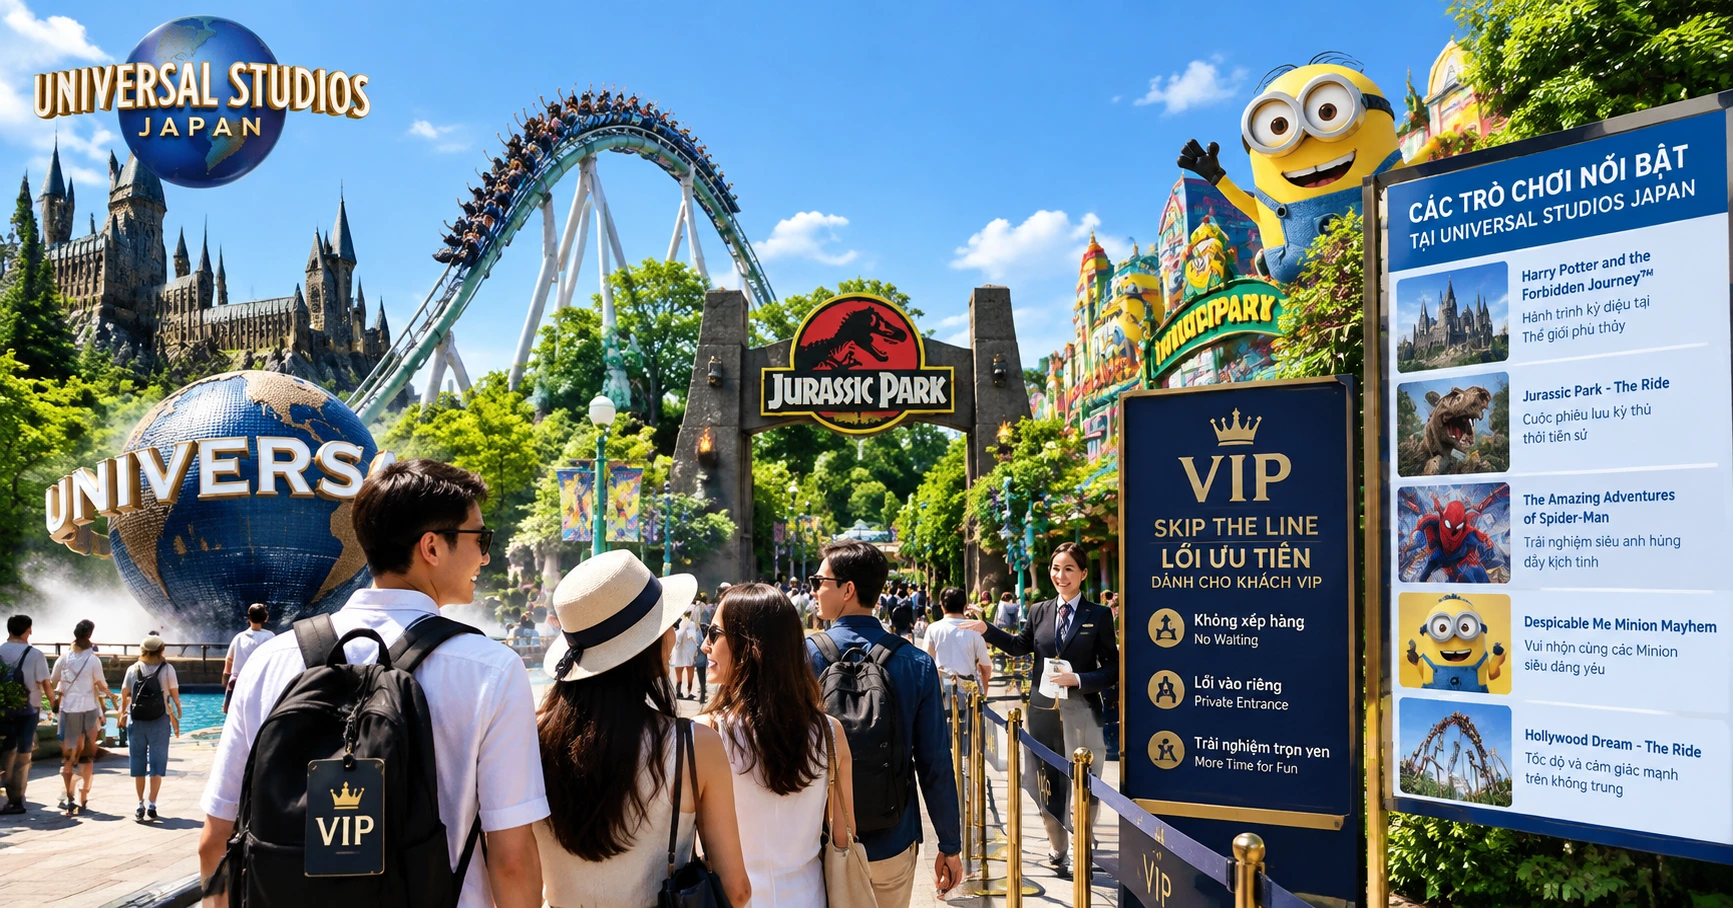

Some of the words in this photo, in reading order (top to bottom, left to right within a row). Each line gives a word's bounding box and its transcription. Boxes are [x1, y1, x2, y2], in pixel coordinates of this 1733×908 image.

[1409, 194, 1453, 223] CÁC
[1459, 181, 1504, 213] TRÒ
[1511, 168, 1571, 202] CHƠI
[1635, 143, 1688, 180] BẬT
[1410, 230, 1434, 252] TẠI
[1441, 211, 1538, 243] UNIVERSAL
[1543, 193, 1624, 224] STUDIOS
[1631, 179, 1695, 207] JAPAN
[1522, 268, 1556, 282] Harry
[1560, 260, 1599, 276] Potter
[1602, 253, 1625, 269] and
[1629, 251, 1651, 264] the
[1522, 282, 1584, 301] Forbidden
[768, 373, 873, 409] JURASSIC
[879, 372, 947, 408] PARK
[1523, 387, 1571, 402] Jurassic
[1574, 383, 1602, 397] Park
[1614, 380, 1637, 393] The
[1641, 376, 1670, 391] Ride
[1178, 453, 1292, 502] VIP
[45, 435, 396, 544] UNIVERS
[1523, 494, 1545, 505] The
[1548, 492, 1600, 506] Amazing
[1603, 490, 1675, 503] Adventures
[1154, 519, 1206, 537] SKIP
[1212, 517, 1257, 536] THE
[1266, 516, 1318, 535] LINE
[1523, 512, 1536, 525] of
[1539, 511, 1610, 527] Spider-Man
[1623, 535, 1645, 547] anh
[1199, 576, 1232, 588] CHO
[1237, 572, 1291, 588] KHÁCH
[1297, 576, 1322, 588] VIP
[1524, 615, 1589, 631] Despicable
[1592, 618, 1611, 630] Me
[1615, 618, 1658, 632] Minion
[1661, 619, 1717, 635] Mayhem
[1194, 634, 1211, 645] No
[1524, 640, 1543, 652] Vui
[1636, 644, 1678, 658] Minion
[1218, 677, 1242, 690] vào
[1246, 678, 1282, 695] riêng
[1194, 695, 1233, 708] Private
[1237, 696, 1289, 710] Entrance
[1222, 739, 1270, 755] nghiệm
[1525, 728, 1588, 746] Hollywood
[1592, 735, 1632, 750] Dream
[1644, 740, 1668, 754] The
[1672, 743, 1702, 758] Ride
[1195, 755, 1223, 769] More
[1226, 758, 1254, 771] Time
[1257, 760, 1273, 772] for
[1277, 762, 1298, 774] Fun
[1591, 780, 1623, 798] trung
[315, 815, 374, 846] VIP
[1142, 853, 1172, 907] VIP
